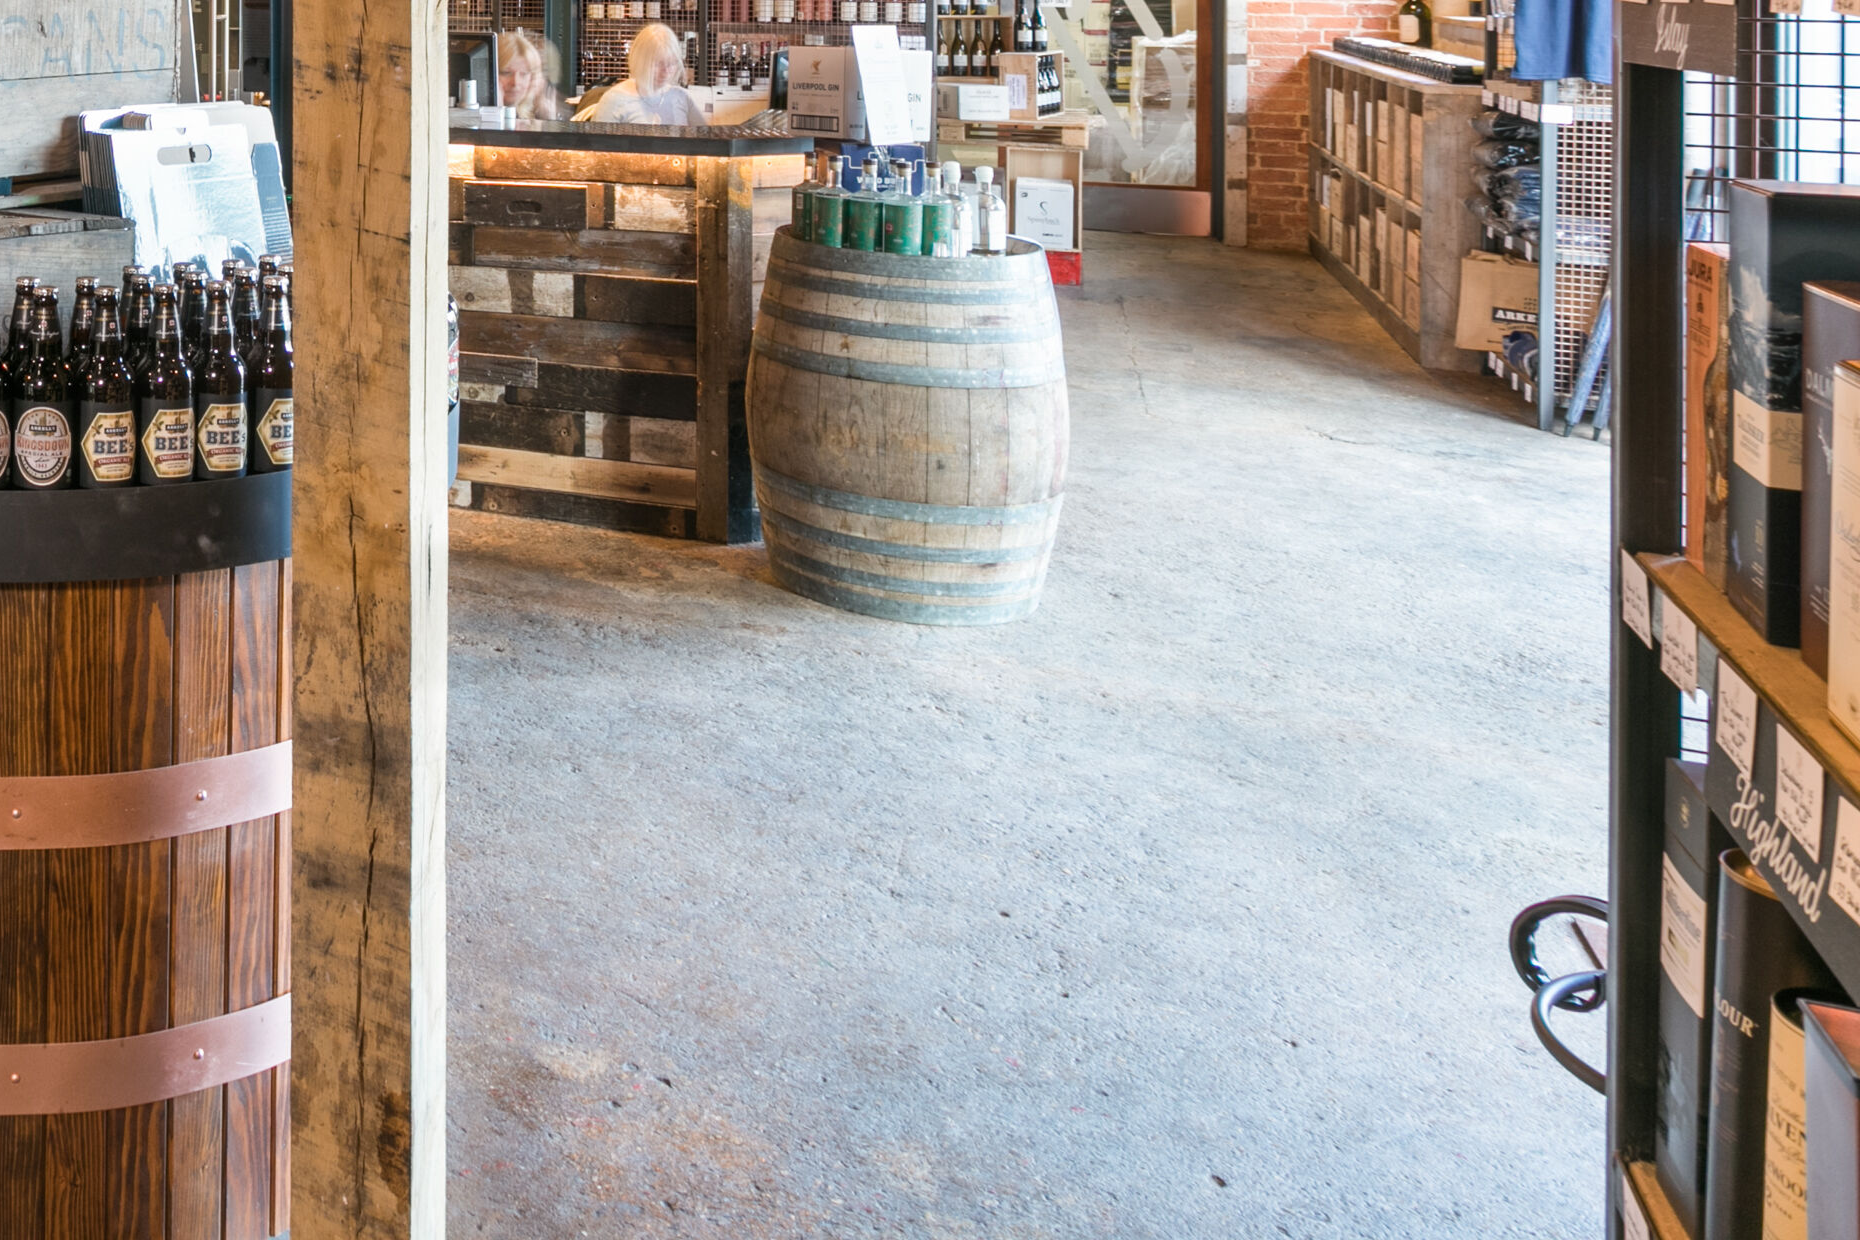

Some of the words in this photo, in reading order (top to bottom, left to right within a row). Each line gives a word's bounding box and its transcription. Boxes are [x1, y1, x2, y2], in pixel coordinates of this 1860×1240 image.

[792, 82, 827, 92] LIVERPOOL
[828, 83, 840, 92] GIN
[1494, 309, 1538, 323] ARKE
[16, 436, 70, 451] KINGSDOWN
[1730, 773, 1827, 923] Highland
